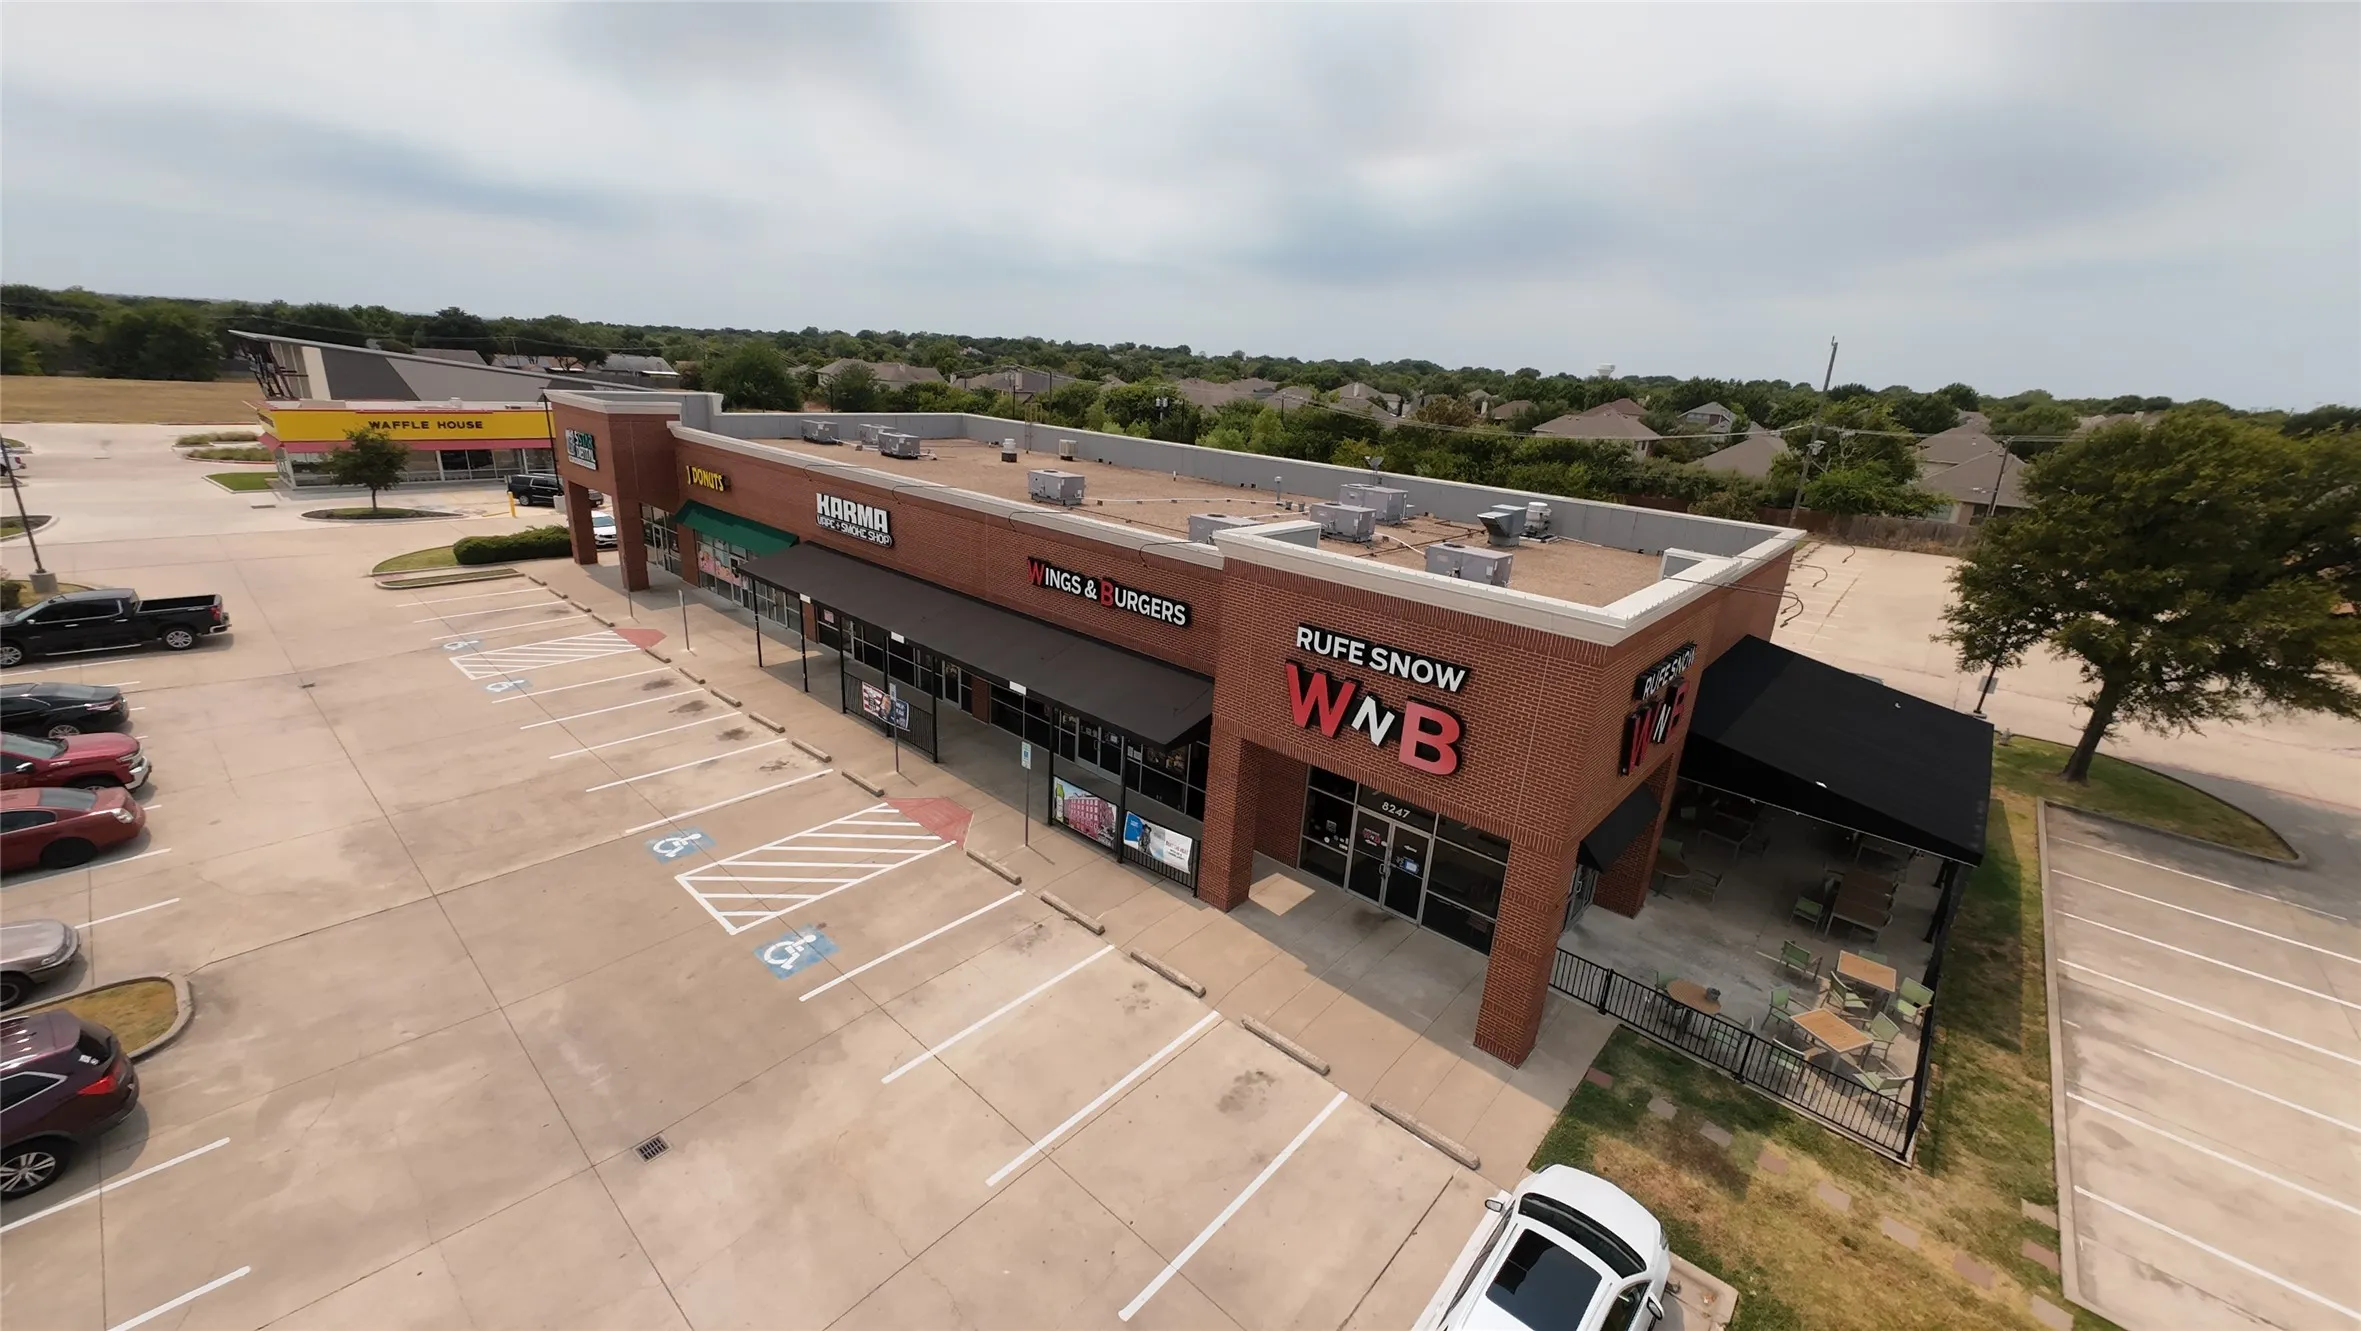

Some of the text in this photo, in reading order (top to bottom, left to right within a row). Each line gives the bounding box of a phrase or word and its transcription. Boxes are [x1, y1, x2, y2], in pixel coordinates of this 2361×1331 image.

[368, 420, 483, 429] WAFFLE HOUSE
[691, 466, 724, 492] DONUTS
[816, 493, 889, 534] KARMA
[817, 514, 835, 529] VAPE
[841, 522, 868, 539] SMOKE
[868, 531, 890, 545] SHOP
[1084, 579, 1098, 600] &
[1296, 626, 1466, 692] RUFE SNOW
[1642, 645, 1696, 700] RUFE SNOW
[1381, 801, 1411, 818] 8247
